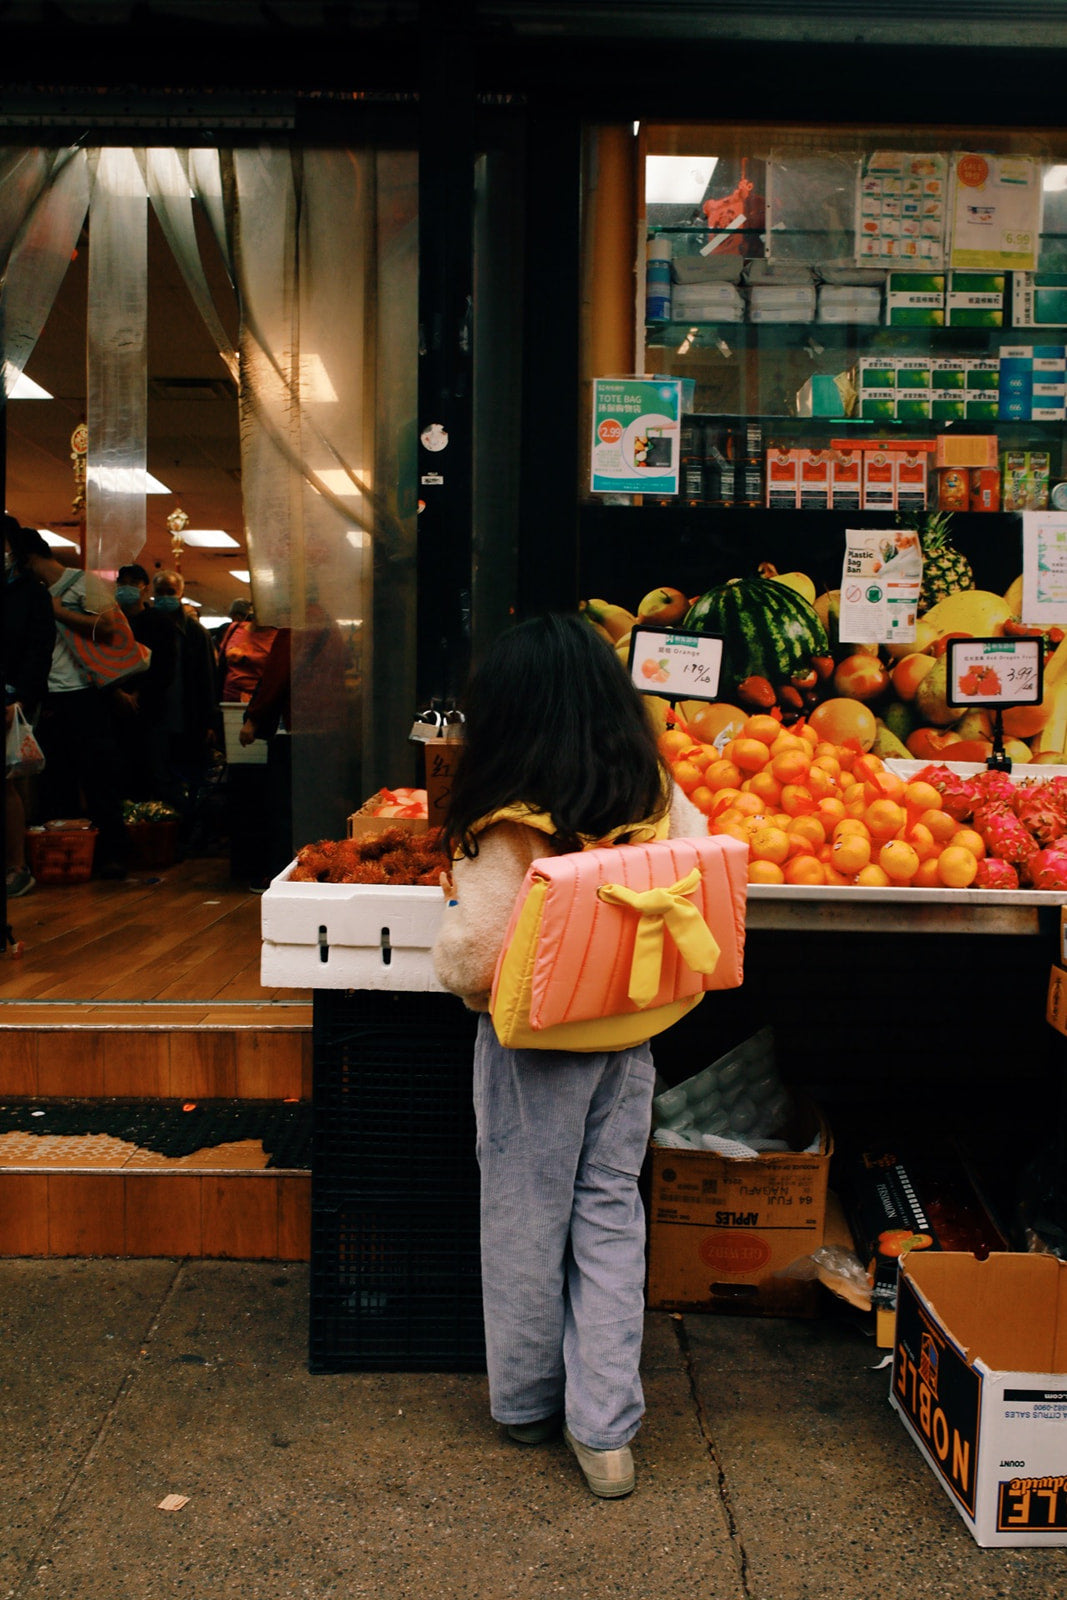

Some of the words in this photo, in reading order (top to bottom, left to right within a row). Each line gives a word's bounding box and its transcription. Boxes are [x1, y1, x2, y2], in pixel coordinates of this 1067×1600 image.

[598, 394, 622, 403] TOTE
[624, 395, 642, 404] BAG
[848, 550, 874, 558] Plastic
[674, 648, 700, 656] Orange
[768, 1196, 792, 1205] FUJI
[715, 1211, 759, 1226] APPLES
[1033, 1404, 1067, 1412] 882-0900
[898, 1342, 970, 1492] NOBLE
[1000, 1460, 1025, 1468] COUNT
[1008, 1488, 1067, 1524] LE
